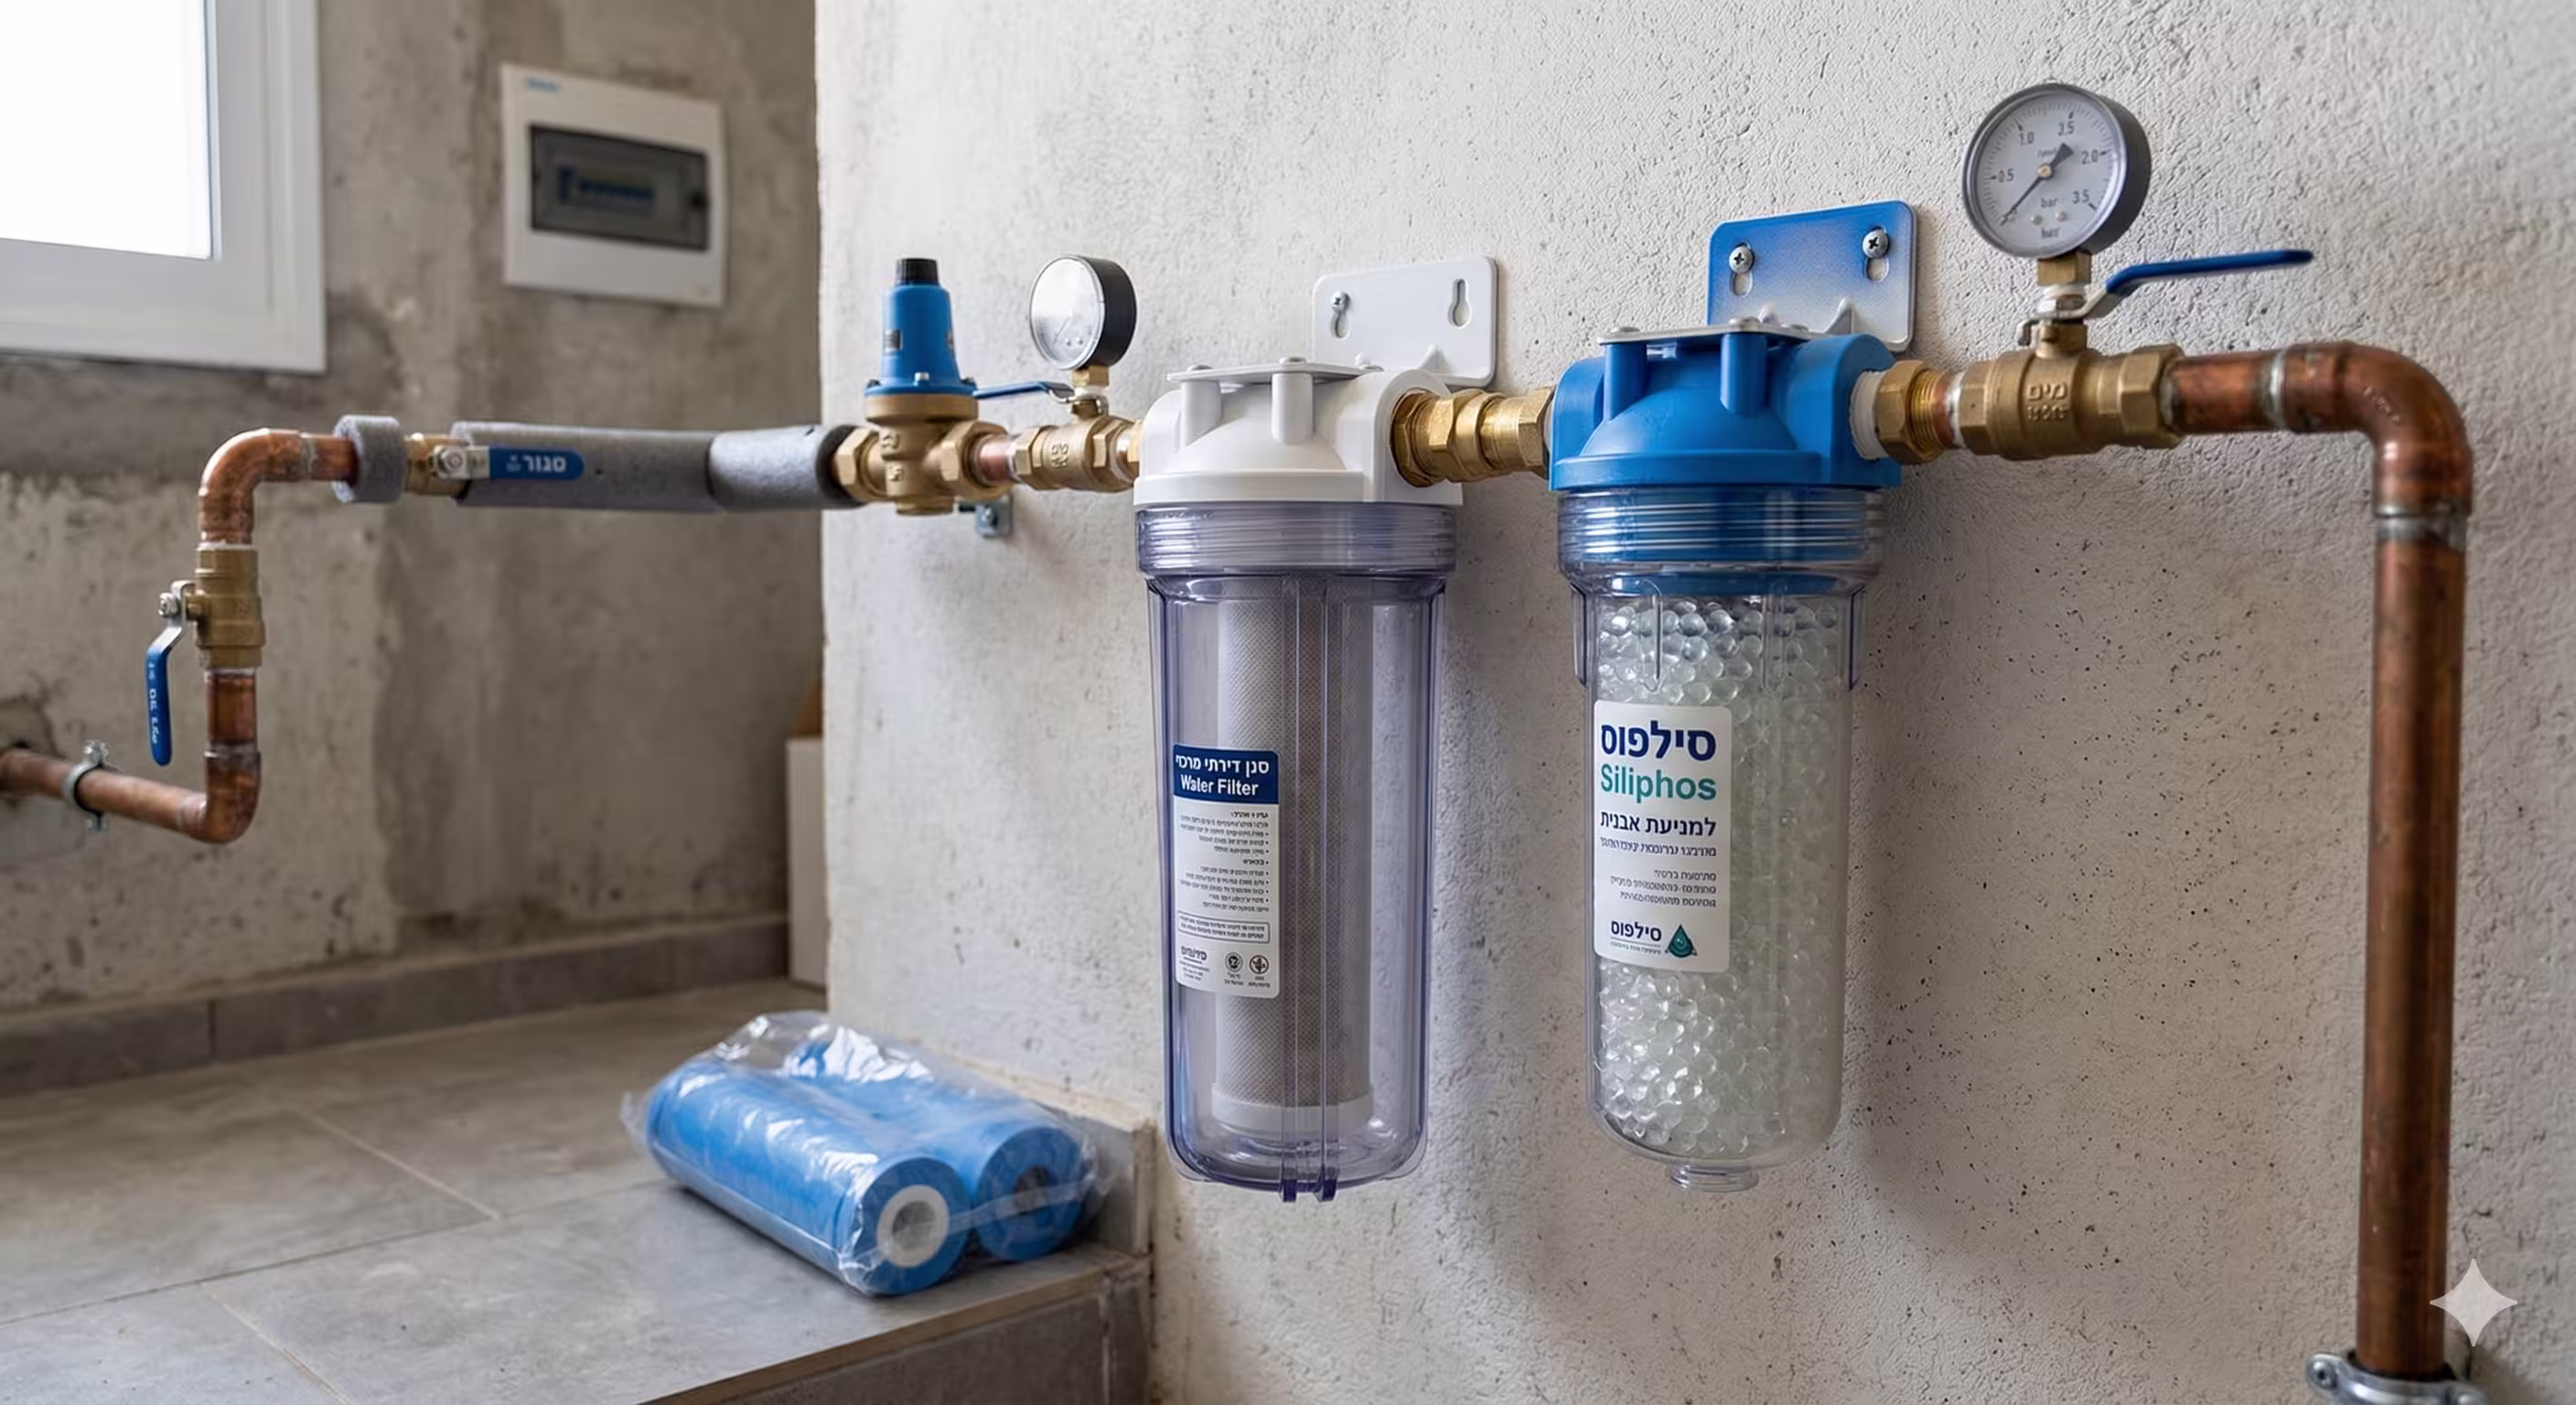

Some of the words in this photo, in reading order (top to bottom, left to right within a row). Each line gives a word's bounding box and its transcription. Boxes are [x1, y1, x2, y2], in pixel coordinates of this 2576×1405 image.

[2081, 150, 2098, 165] 2.0
[521, 455, 567, 473] סגור
[1601, 720, 1717, 761] סילפוס
[1204, 757, 1241, 774] דירתי
[1245, 760, 1270, 778] סנן
[1218, 778, 1260, 796] Filter
[1600, 763, 1717, 803] Siliphos
[1600, 811, 1640, 831] אבנית
[1645, 817, 1717, 836] למניעת
[1610, 920, 1662, 942] סילפוס
